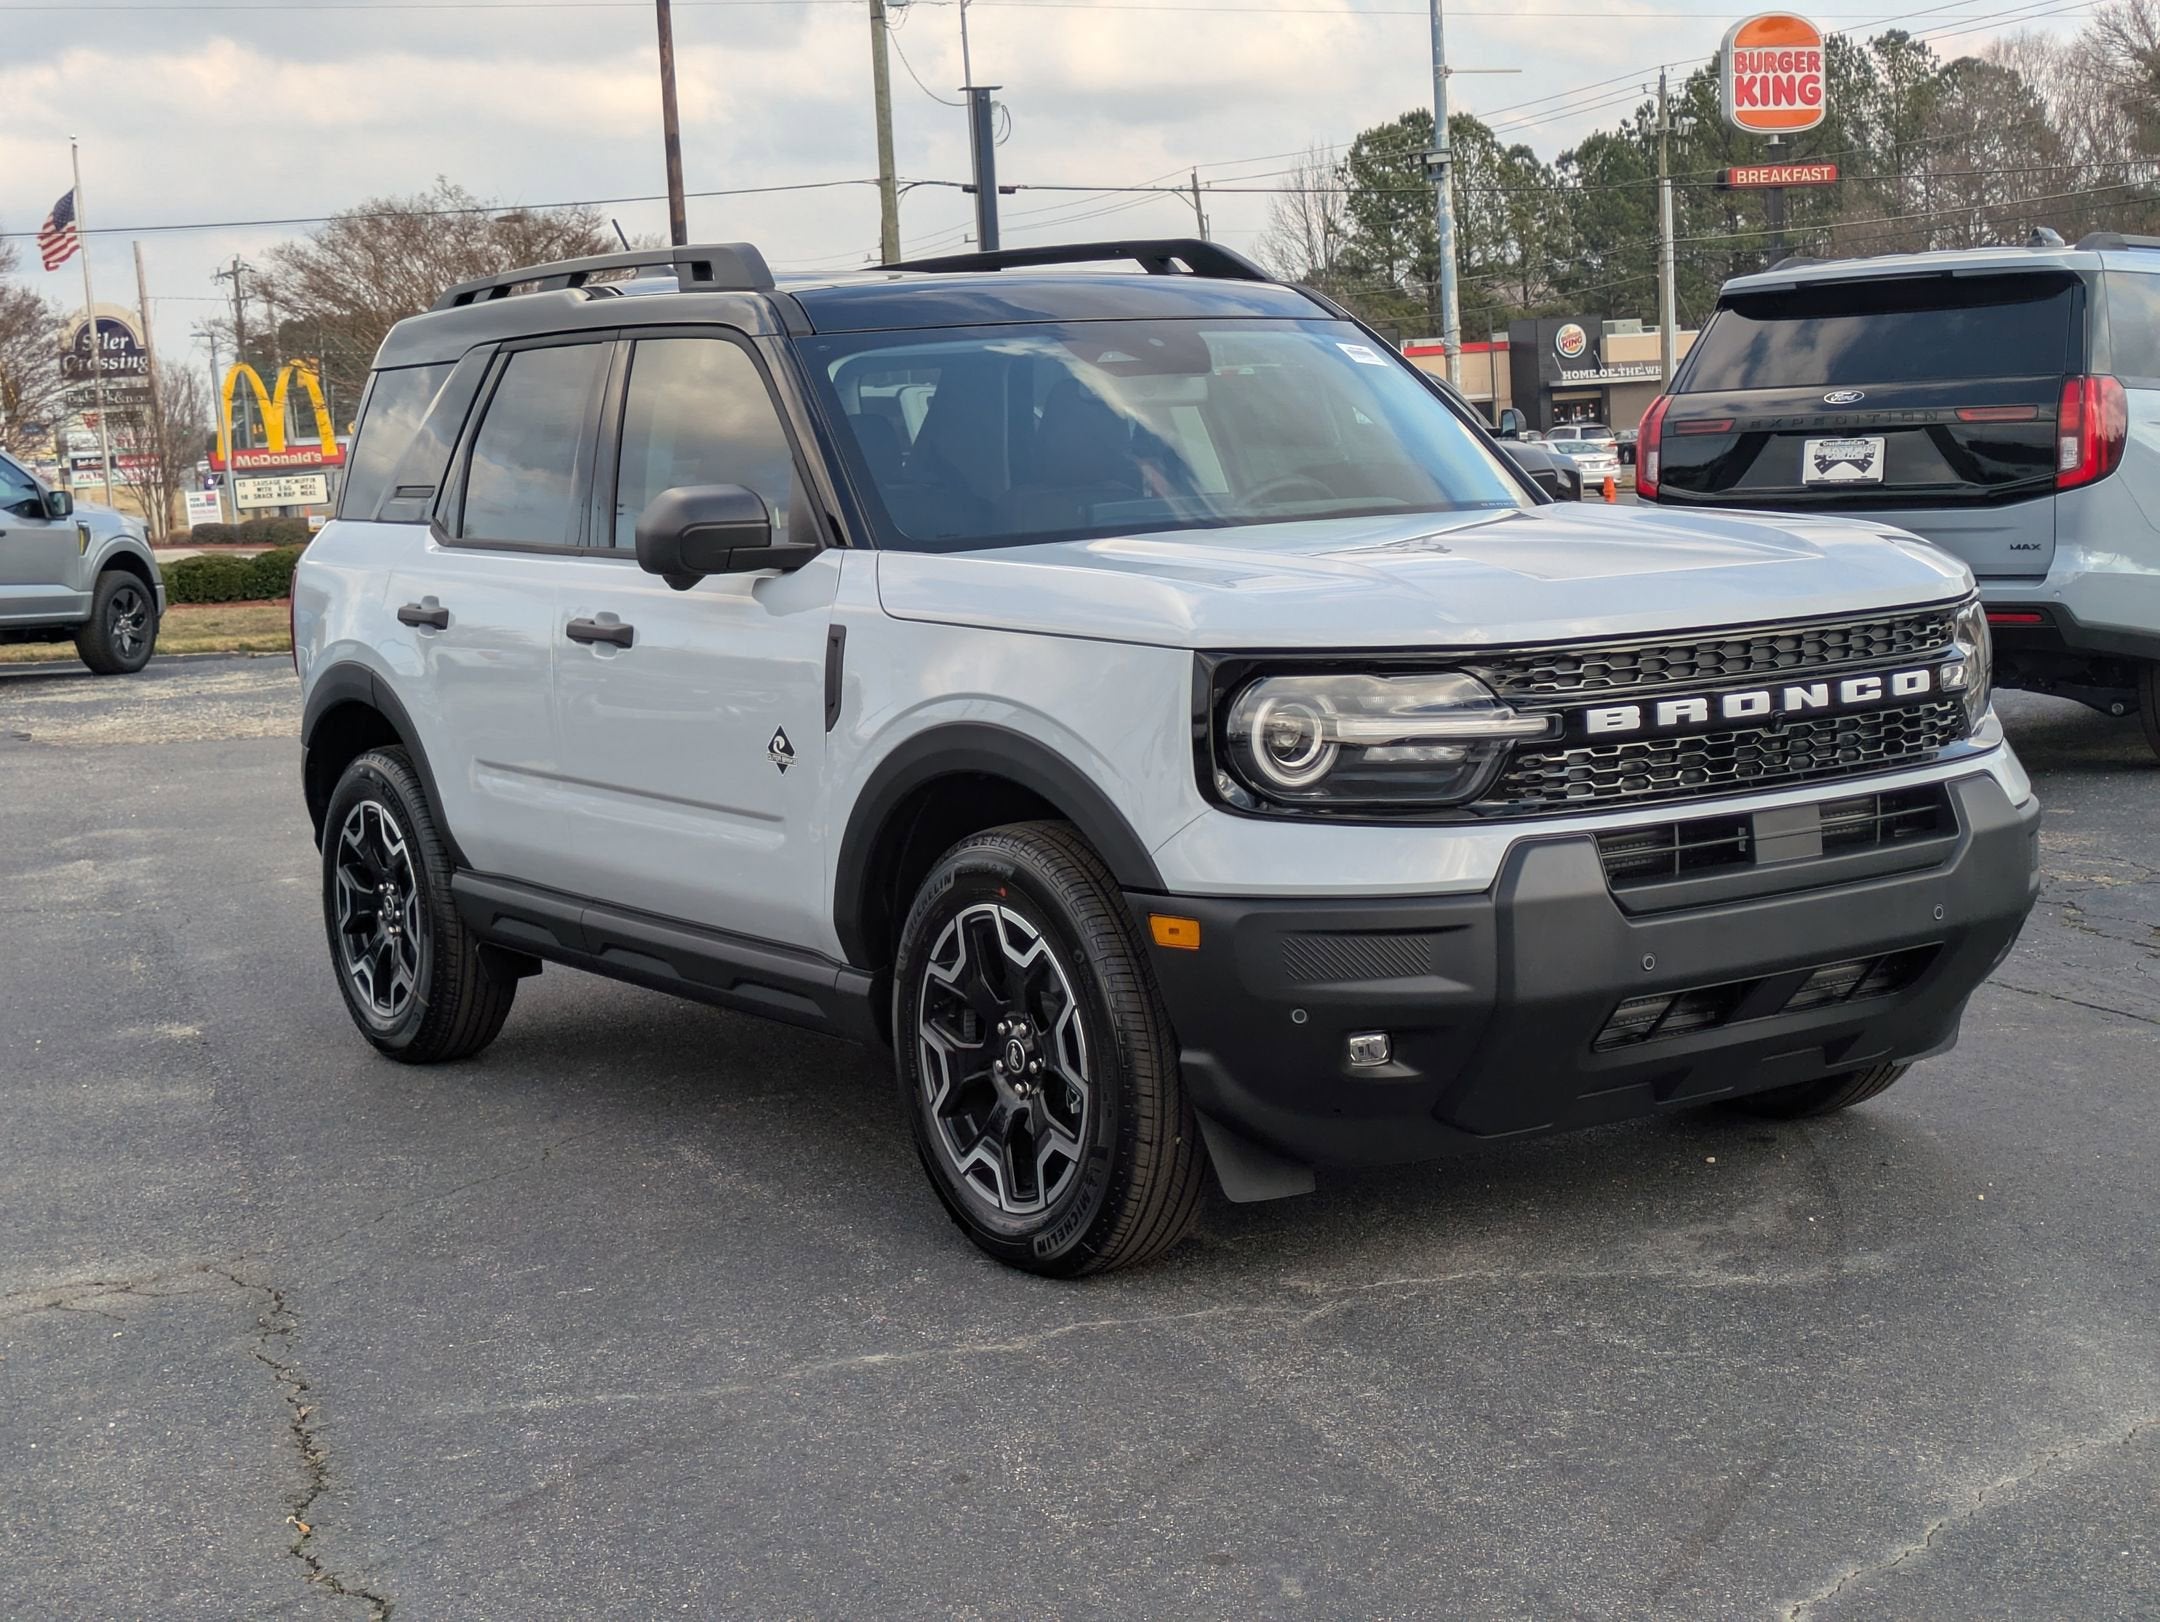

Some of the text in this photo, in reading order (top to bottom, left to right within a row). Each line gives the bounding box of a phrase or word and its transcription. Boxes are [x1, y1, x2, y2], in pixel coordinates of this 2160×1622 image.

[1734, 51, 1821, 74] BURGER
[1734, 74, 1822, 106] KING
[1736, 167, 1831, 184] BREAKFAST
[1561, 335, 1583, 349] KING
[1562, 365, 1662, 380] HOME OF THE WH
[1830, 391, 1858, 403] Ford
[1750, 409, 1938, 429] EXPEDITION
[236, 452, 322, 466] McDonald's
[2010, 543, 2041, 551] MAX
[1586, 669, 1931, 734] BRONCO
[1037, 1186, 1091, 1254] MICHELIN
